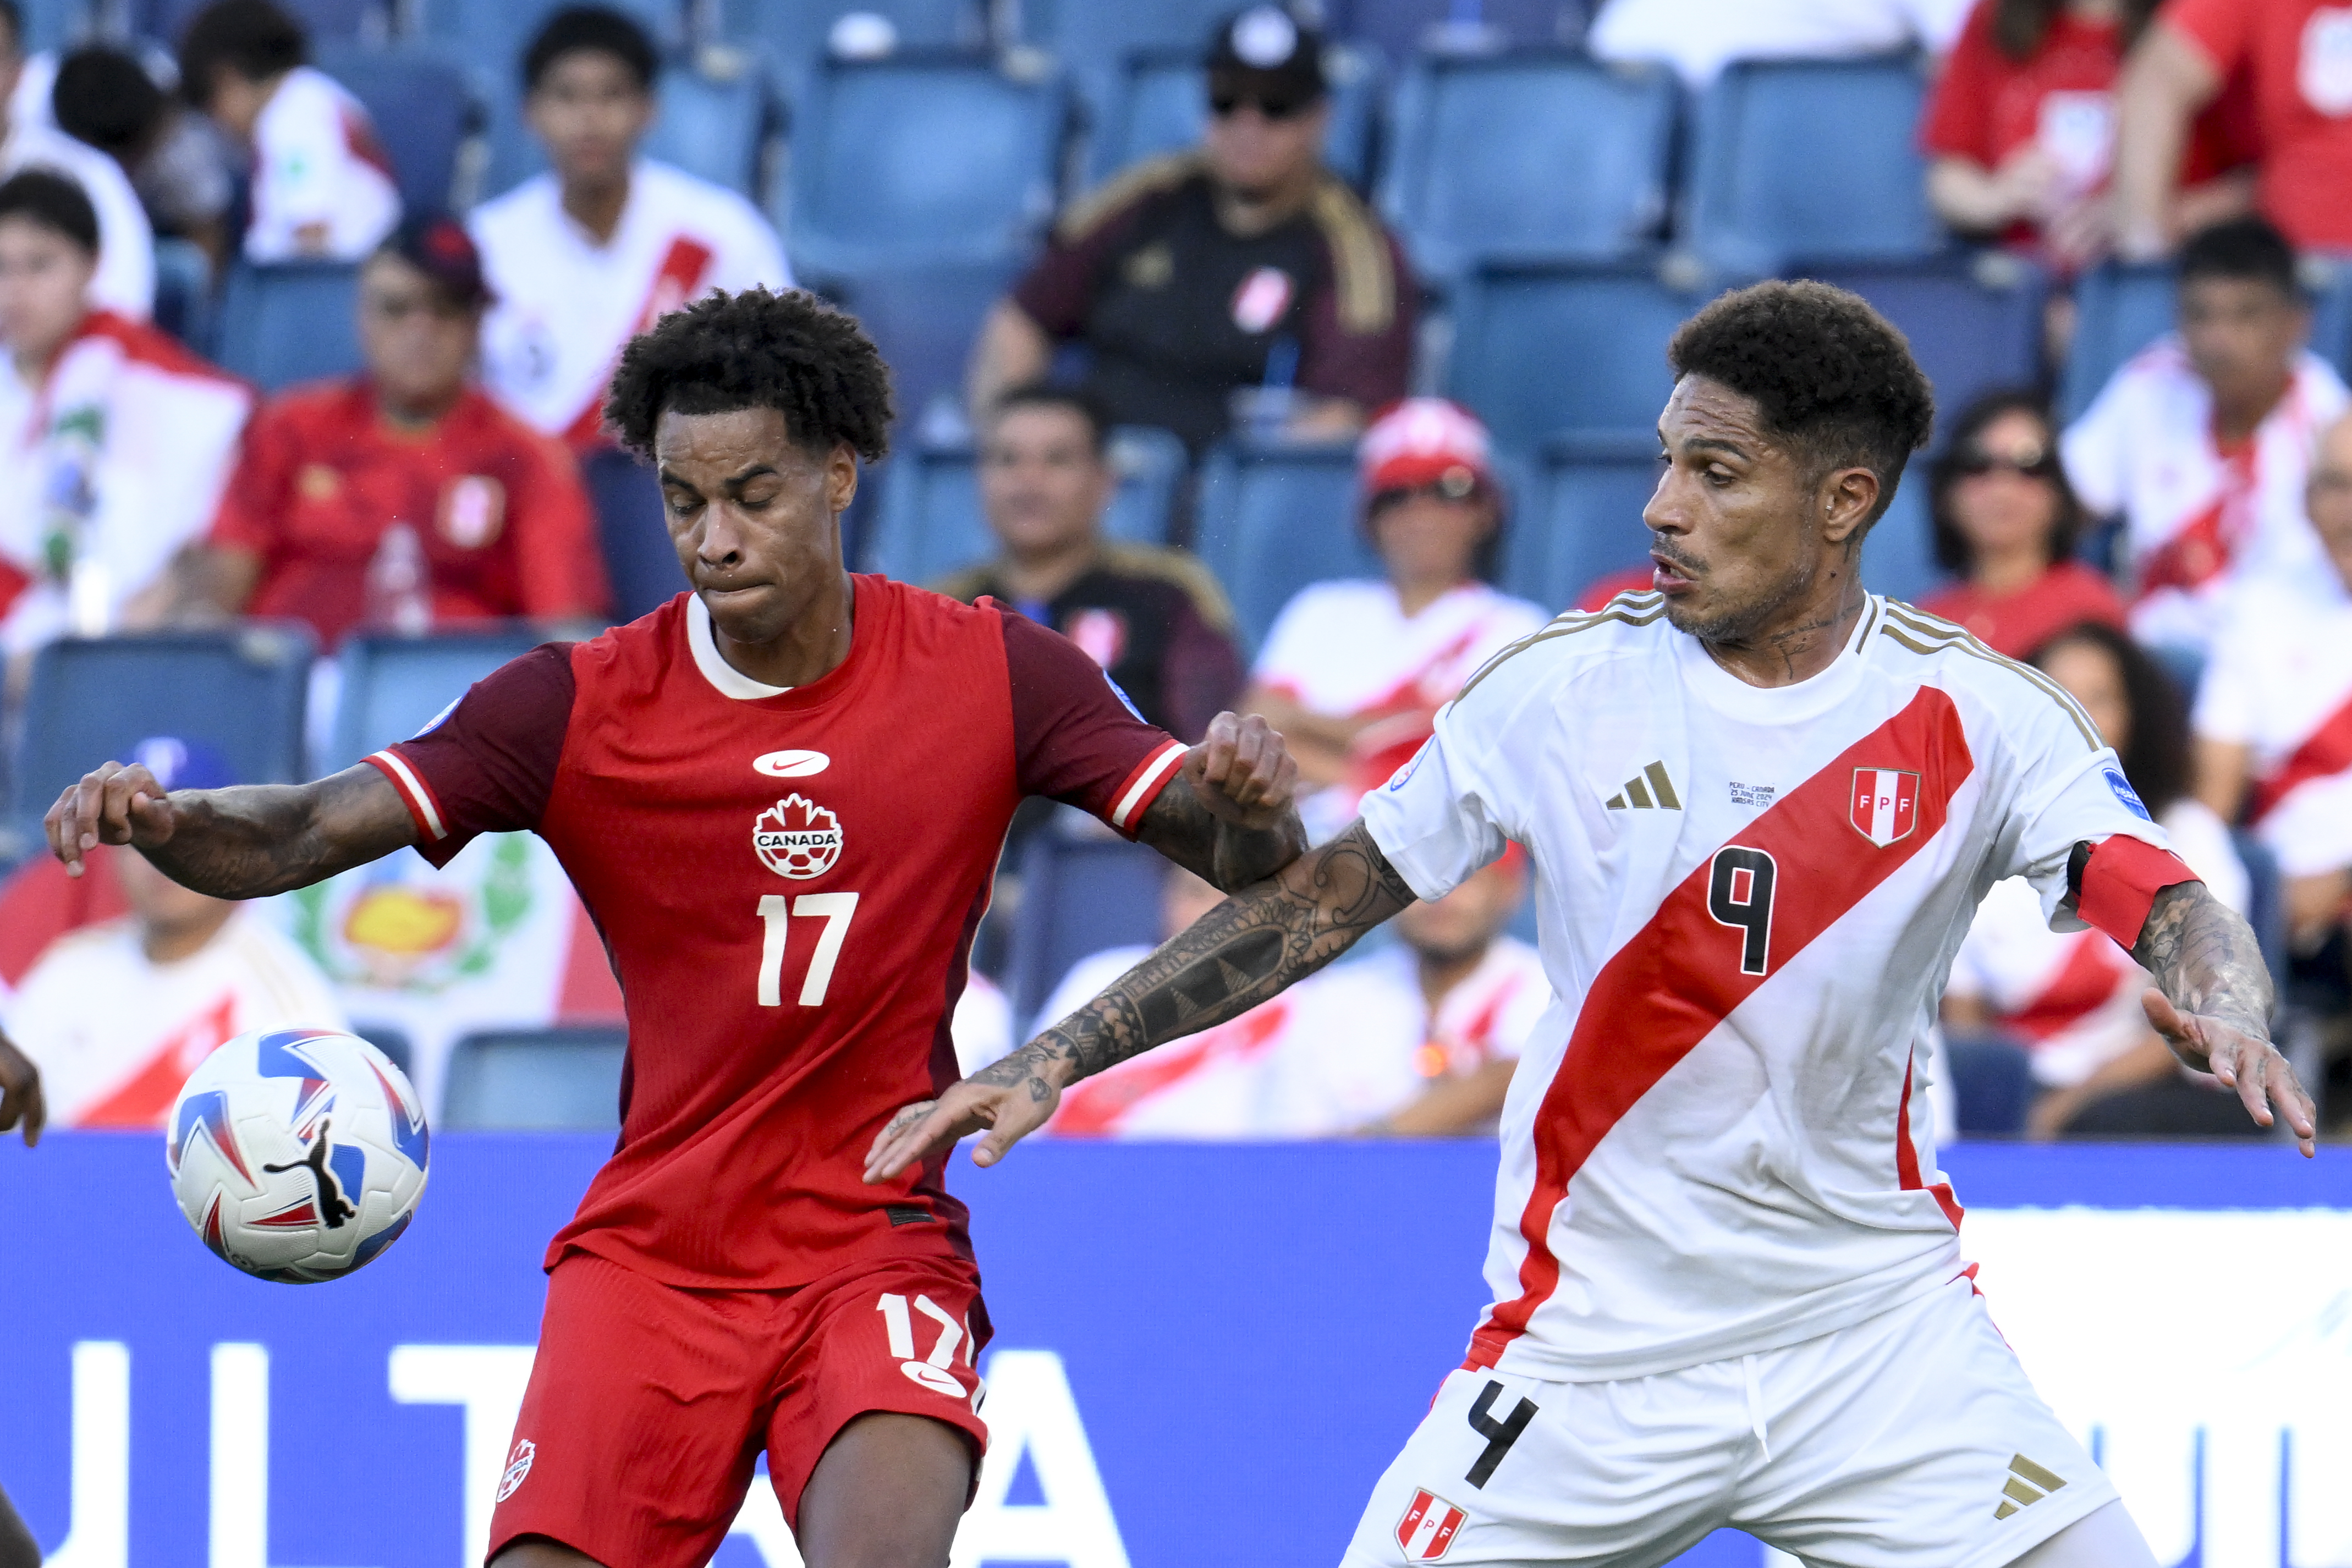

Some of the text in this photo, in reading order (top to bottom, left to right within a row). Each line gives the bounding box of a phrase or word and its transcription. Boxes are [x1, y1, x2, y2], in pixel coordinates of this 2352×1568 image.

[757, 833, 837, 846] CANADA
[756, 892, 859, 1006] 17
[1707, 845, 1778, 976] 9
[876, 1293, 964, 1369] 17
[1465, 1379, 1540, 1490] 4
